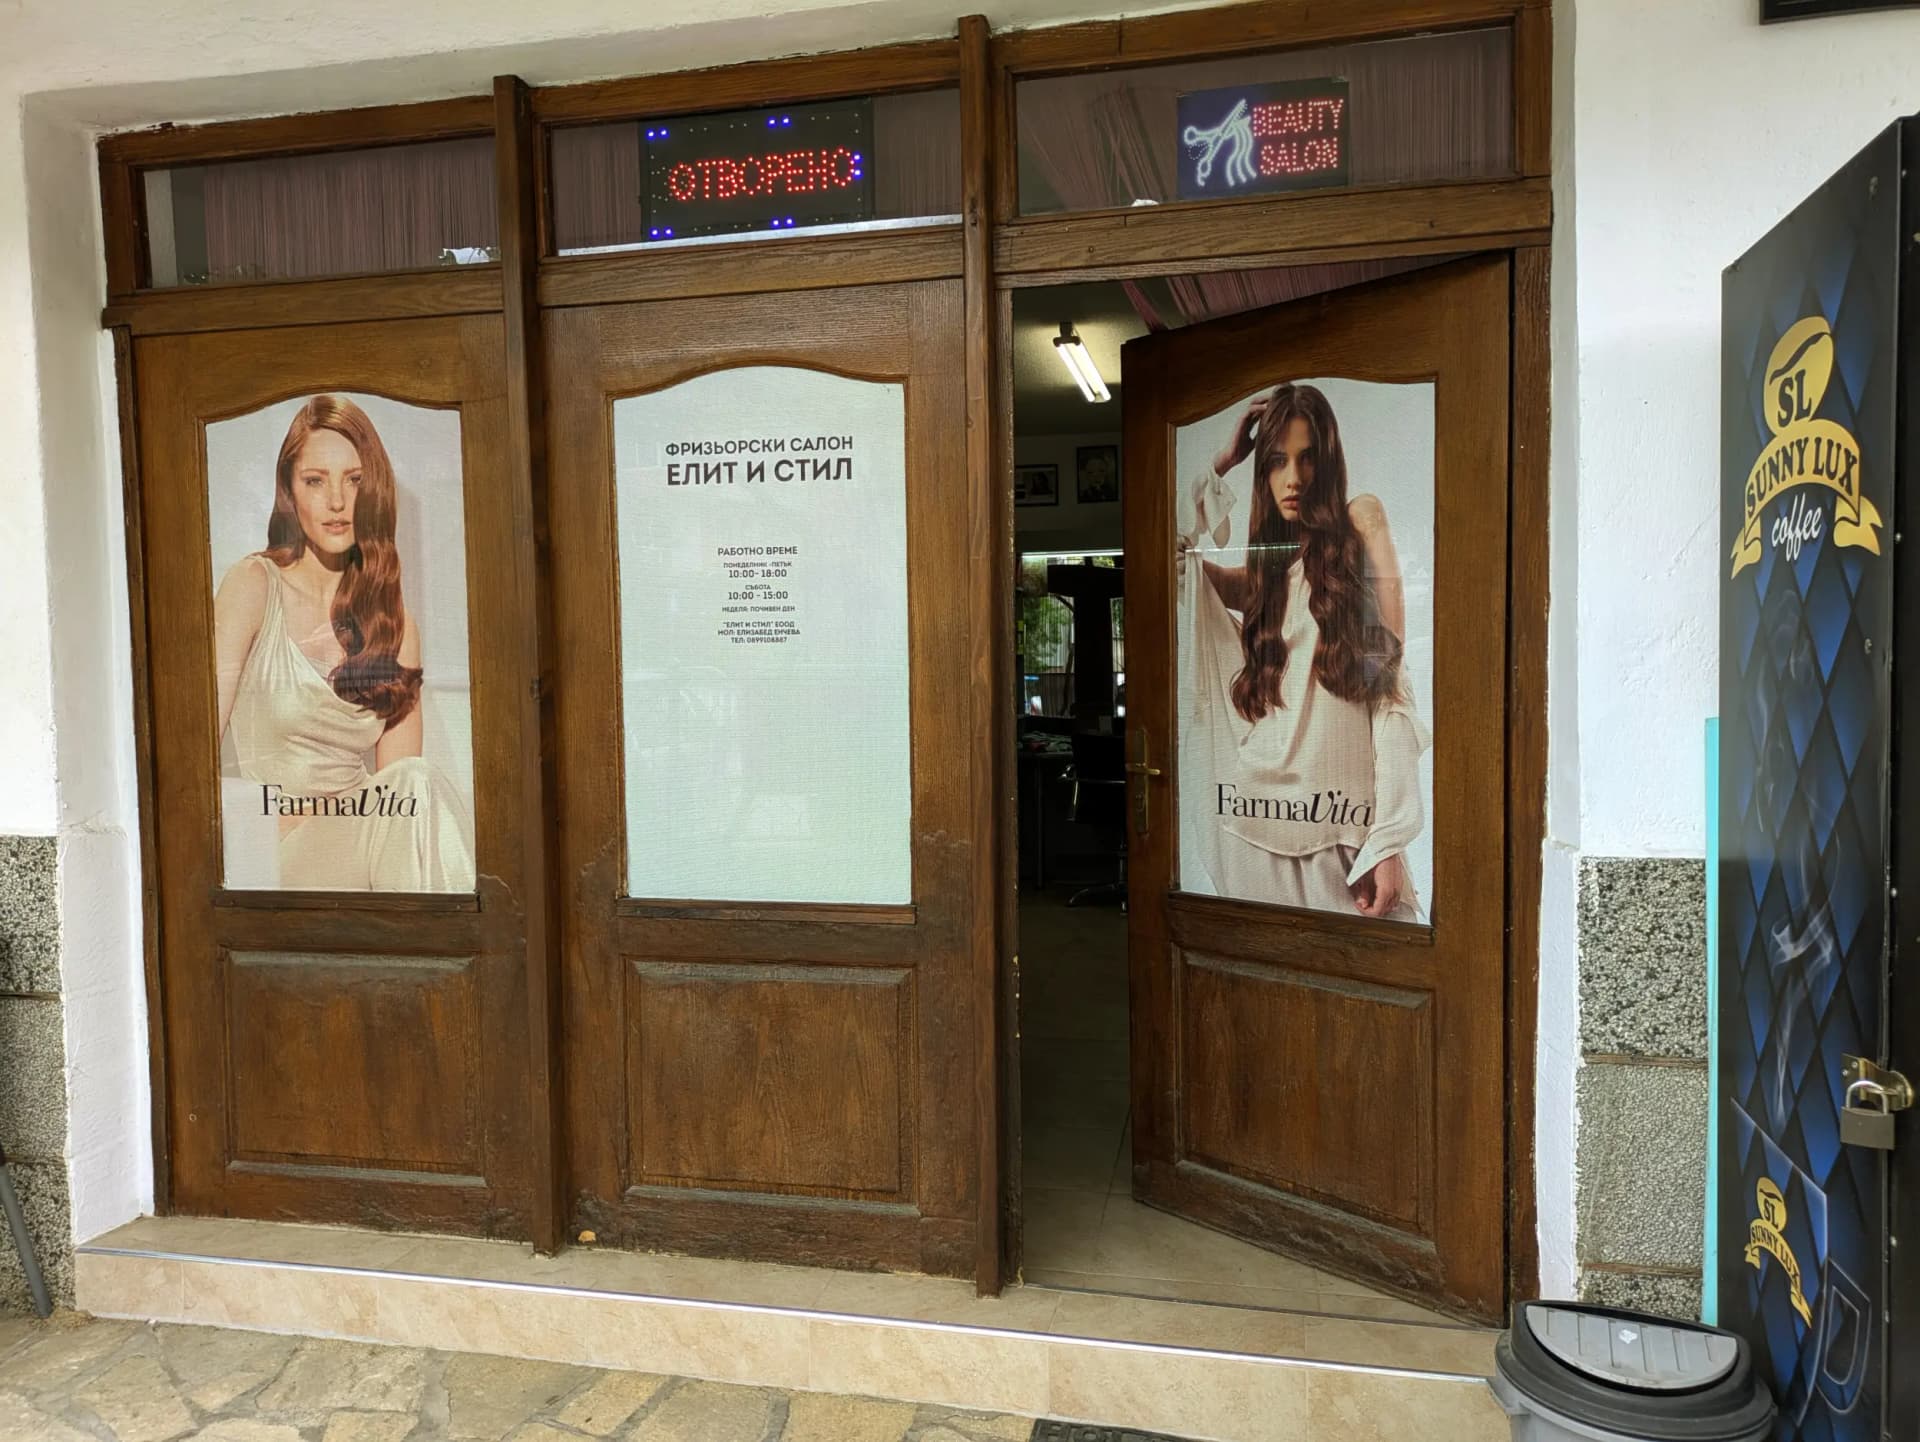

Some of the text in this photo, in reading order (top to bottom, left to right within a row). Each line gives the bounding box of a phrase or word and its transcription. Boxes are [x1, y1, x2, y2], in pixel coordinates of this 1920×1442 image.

[1253, 98, 1344, 136] BEAUTY
[1260, 137, 1338, 175] SALON
[668, 147, 856, 201] ОТВОРЕНО
[1777, 369, 1812, 427] SL
[665, 436, 853, 456] ФРИЗЬОРСКИ САЛОН
[667, 458, 852, 486] ЕЛИТ И СТИЛ
[1746, 436, 1857, 517] SUNNY LUX
[1771, 492, 1823, 562] coffee
[718, 546, 798, 556] РАБОТНО ВРЕМЕ
[761, 569, 787, 578] 18:00
[728, 592, 754, 600] 10:00
[763, 591, 788, 600] 15:00
[259, 784, 419, 818] FarmaVita
[1215, 783, 1373, 827] FarmaVita
[1763, 1199, 1779, 1230] SL
[1751, 1226, 1778, 1252] SUNNY
